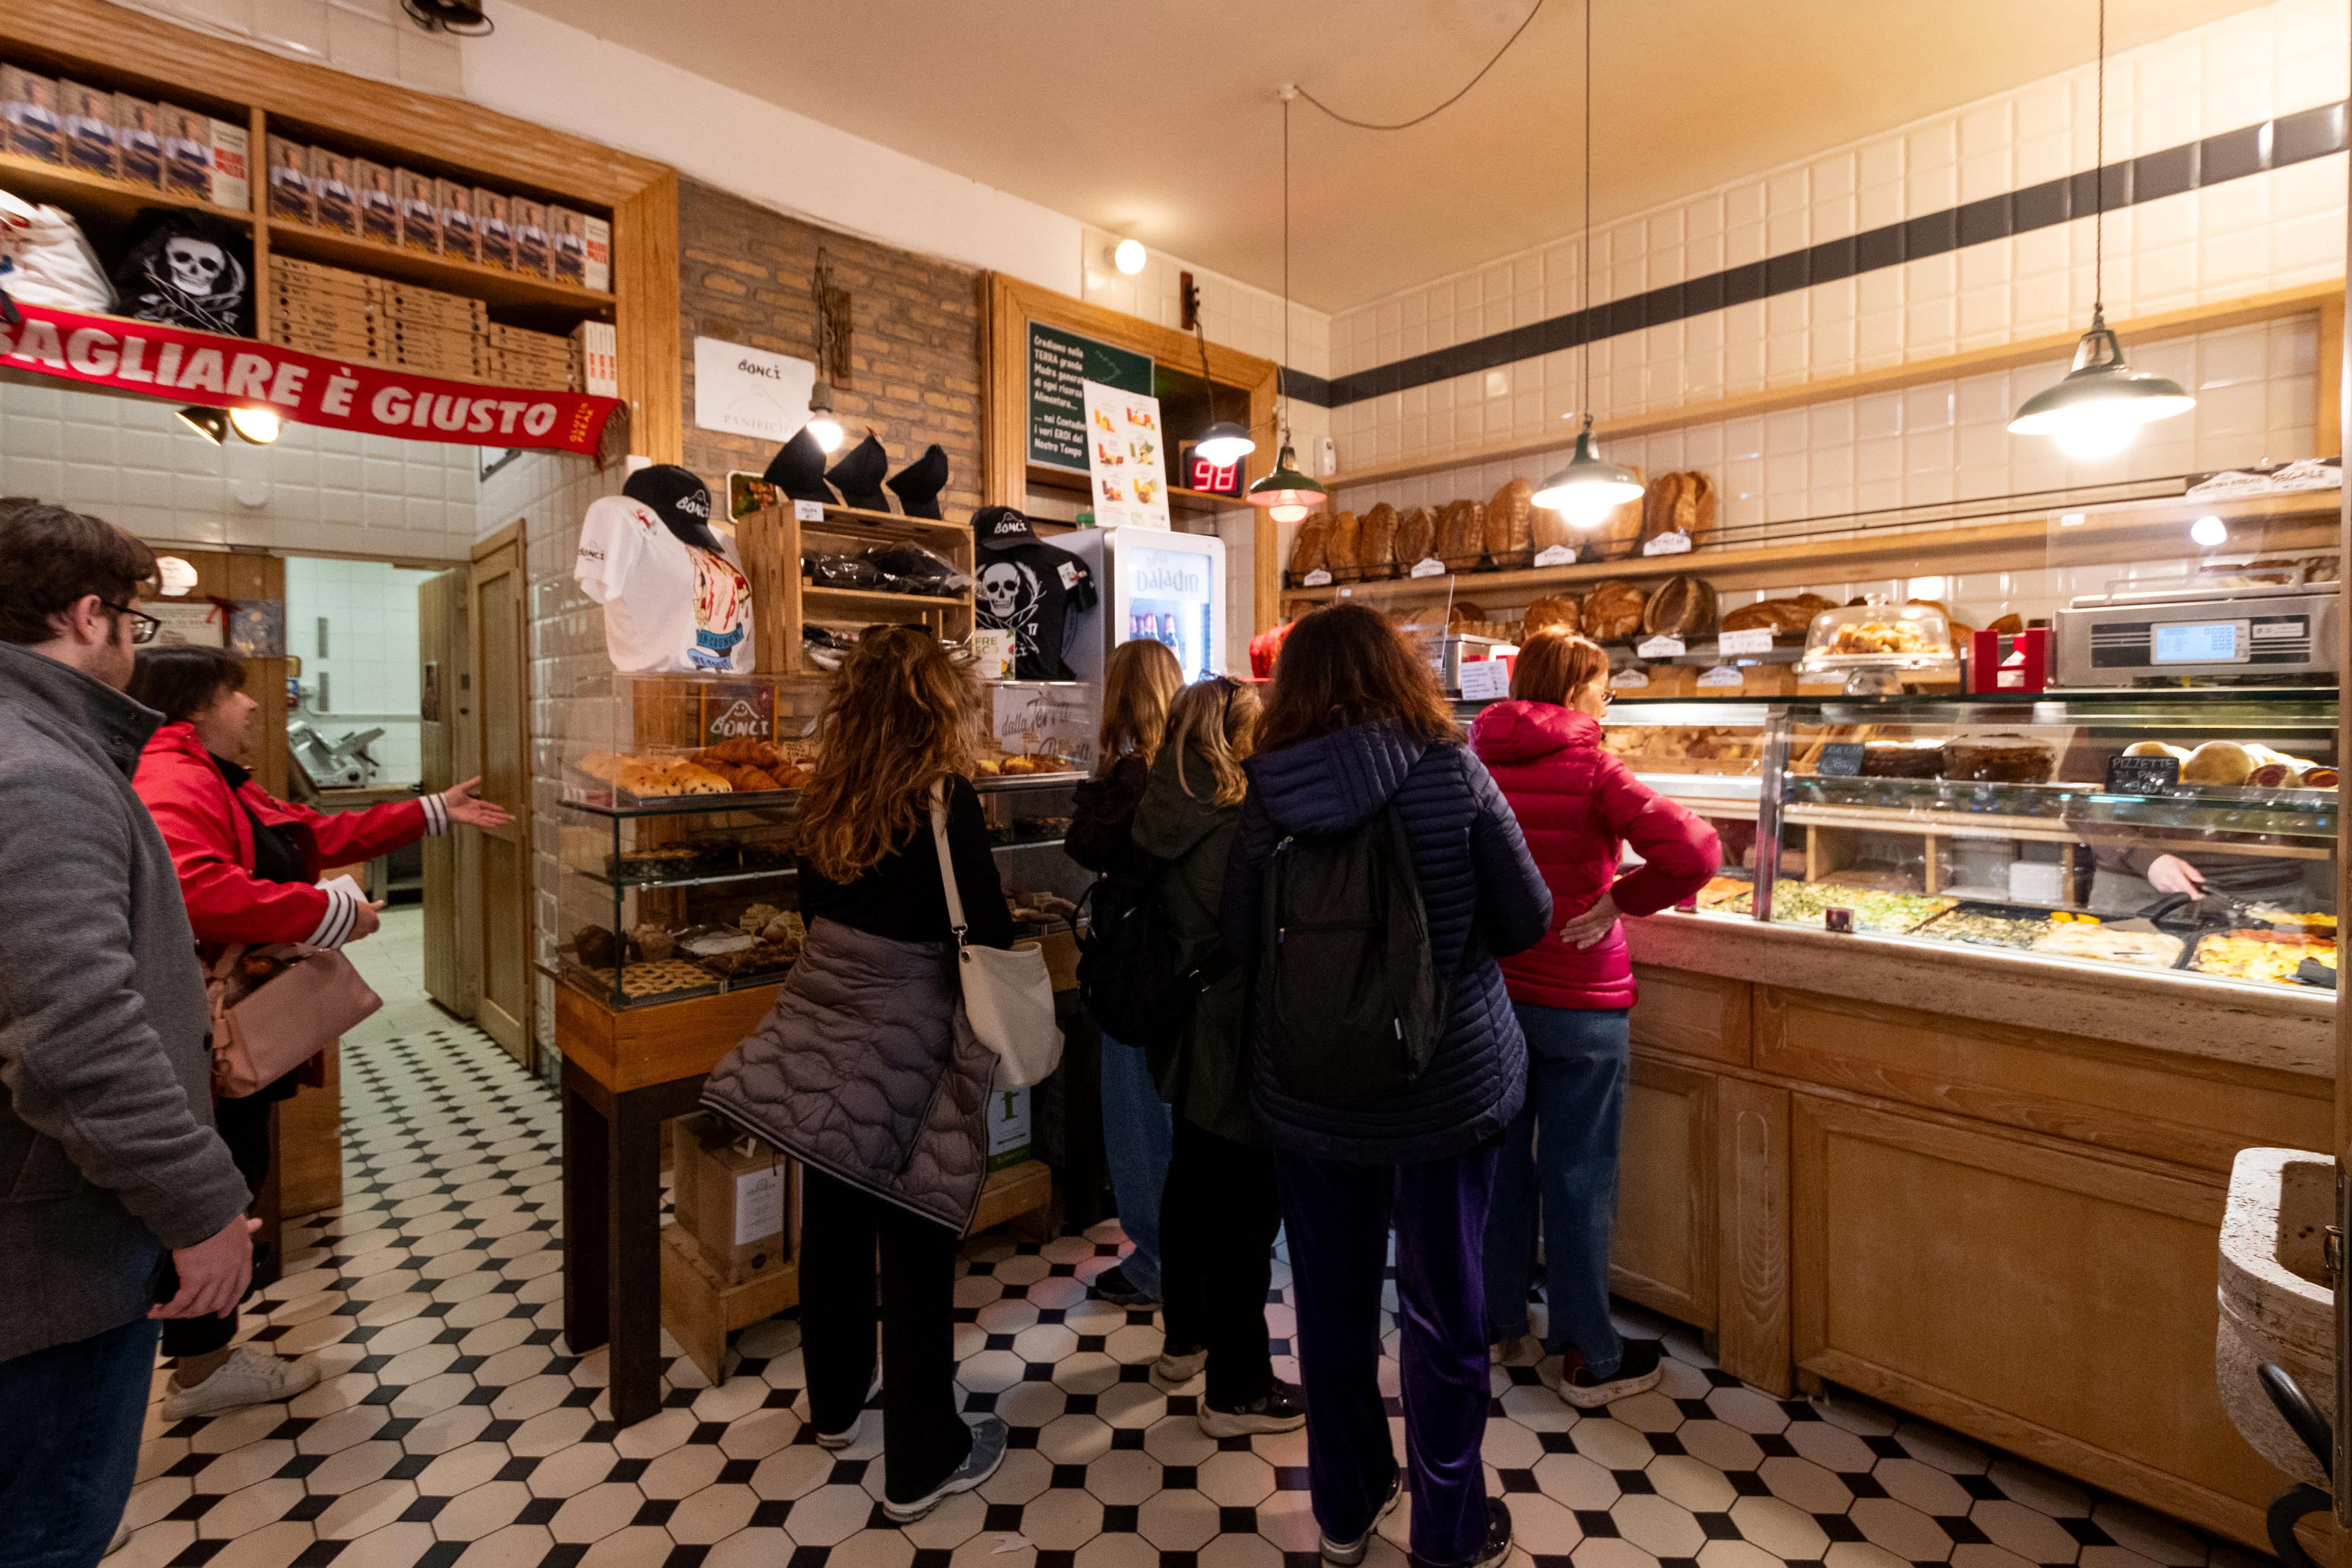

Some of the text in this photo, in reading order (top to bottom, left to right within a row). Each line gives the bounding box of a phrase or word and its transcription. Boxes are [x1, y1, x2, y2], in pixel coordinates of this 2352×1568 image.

[1034, 348, 1058, 364] TERRA
[1033, 362, 1057, 377] Madre
[1033, 377, 1041, 388] di
[320, 366, 360, 417] È
[371, 386, 557, 437] GIUSTO
[1193, 460, 1236, 491] 98
[993, 519, 1028, 534] BONCI
[1027, 622, 1039, 636] 17
[1001, 713, 1028, 736] dalla
[2111, 756, 2176, 769] PIZZETTE
